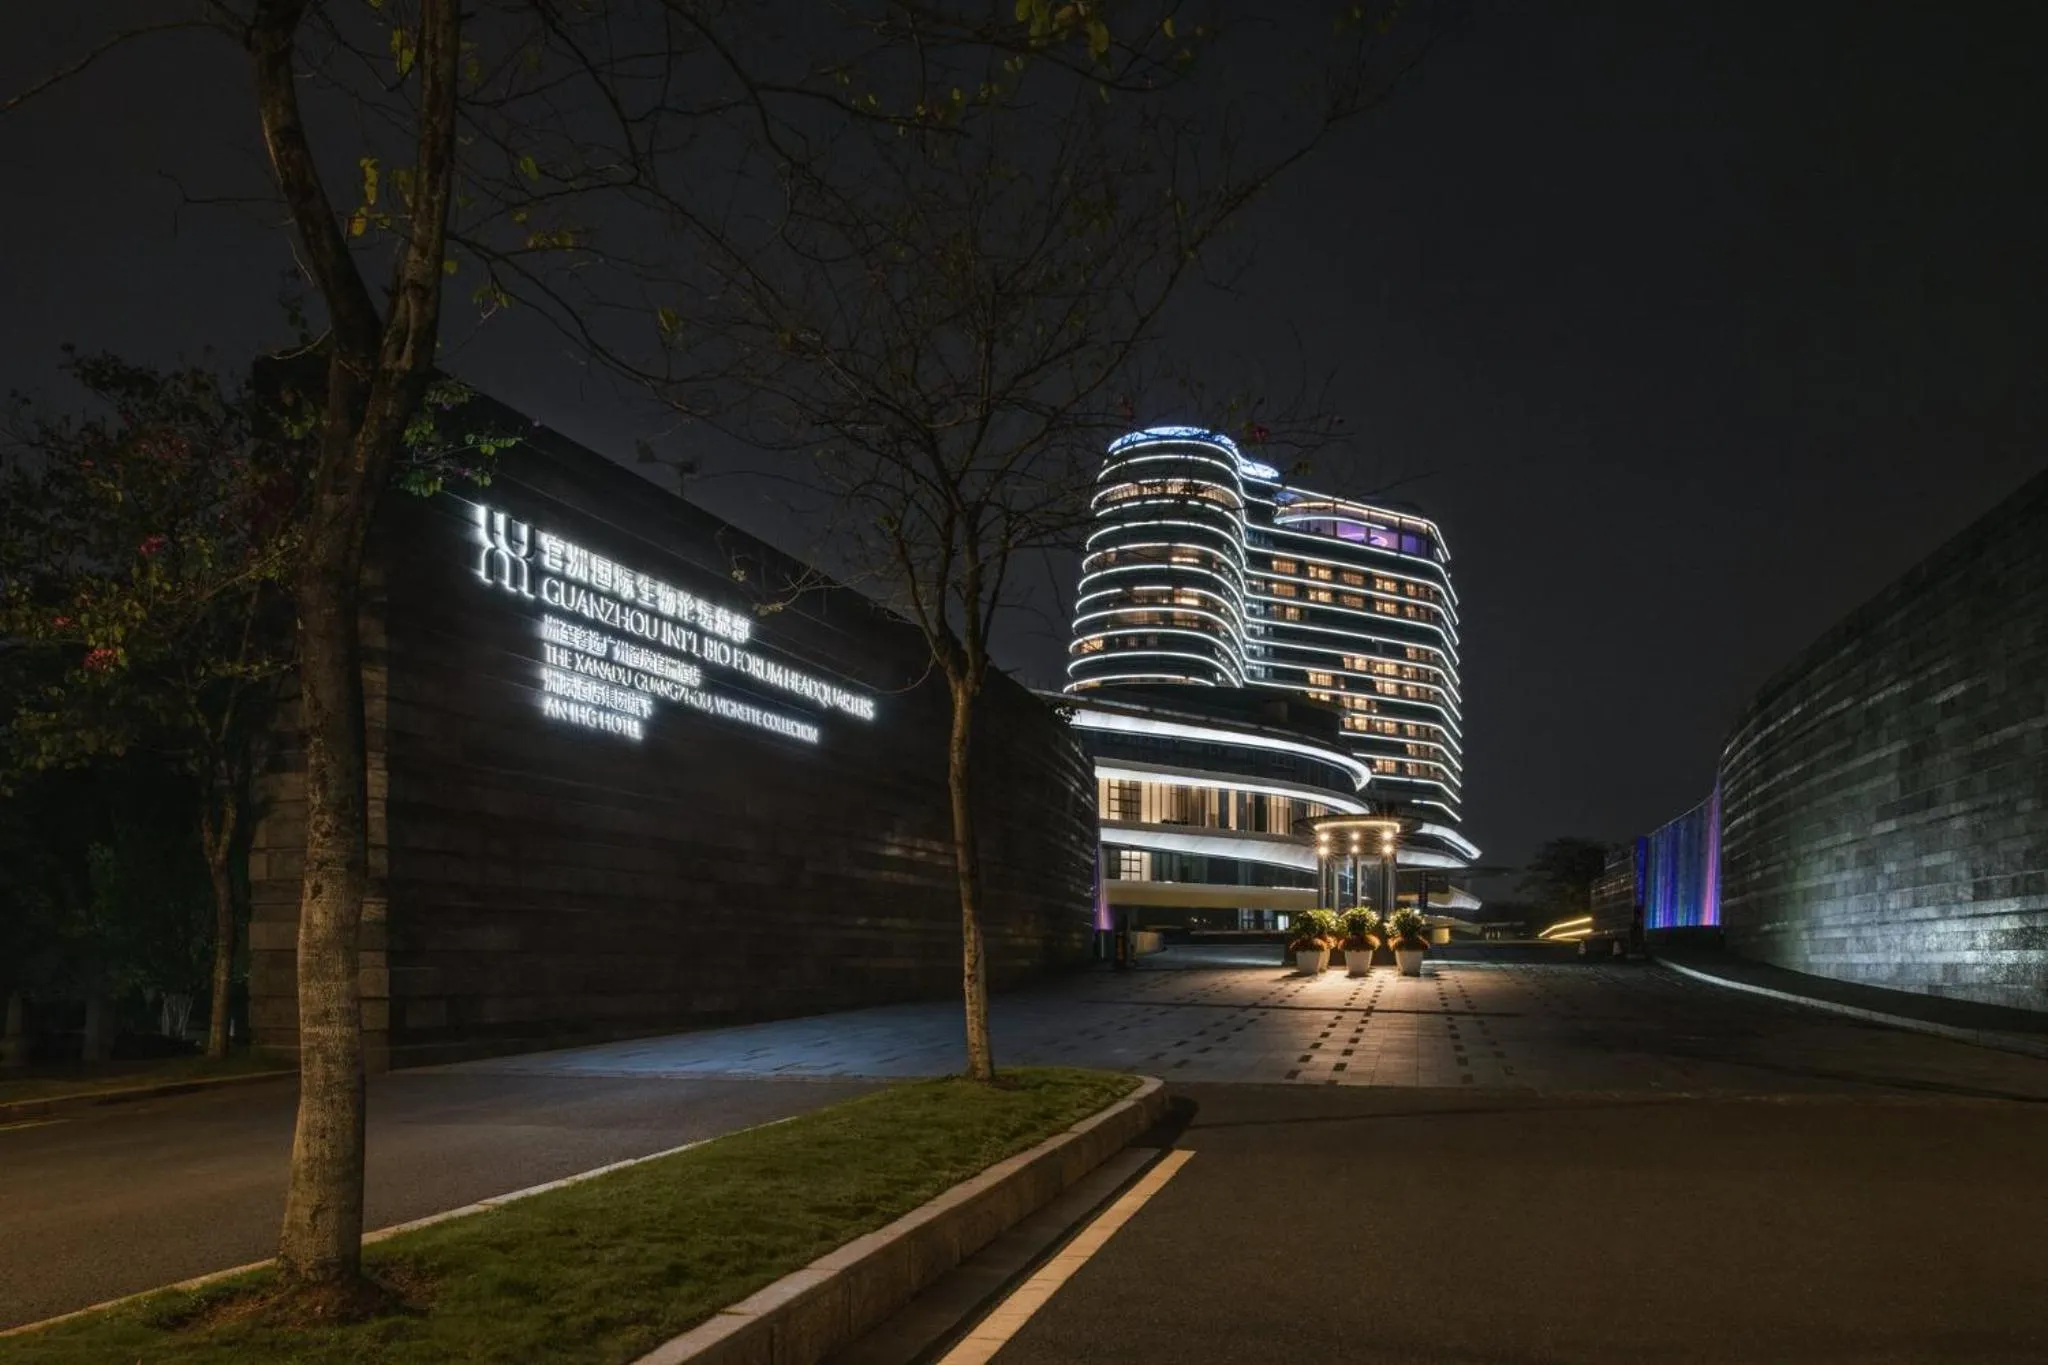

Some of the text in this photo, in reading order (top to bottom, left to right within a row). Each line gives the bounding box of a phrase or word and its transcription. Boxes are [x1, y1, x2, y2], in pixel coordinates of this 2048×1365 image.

[542, 577, 658, 640] GUANZHOU
[703, 636, 731, 667] BIO
[732, 649, 783, 687] FORUM
[783, 665, 876, 721] HEADQUARTERS
[544, 642, 573, 670] THE
[574, 652, 632, 686] XANADU
[714, 694, 762, 726] VIGNETTE
[762, 711, 819, 744] COLLECTION
[544, 696, 644, 742] AN IHG HOTEL
